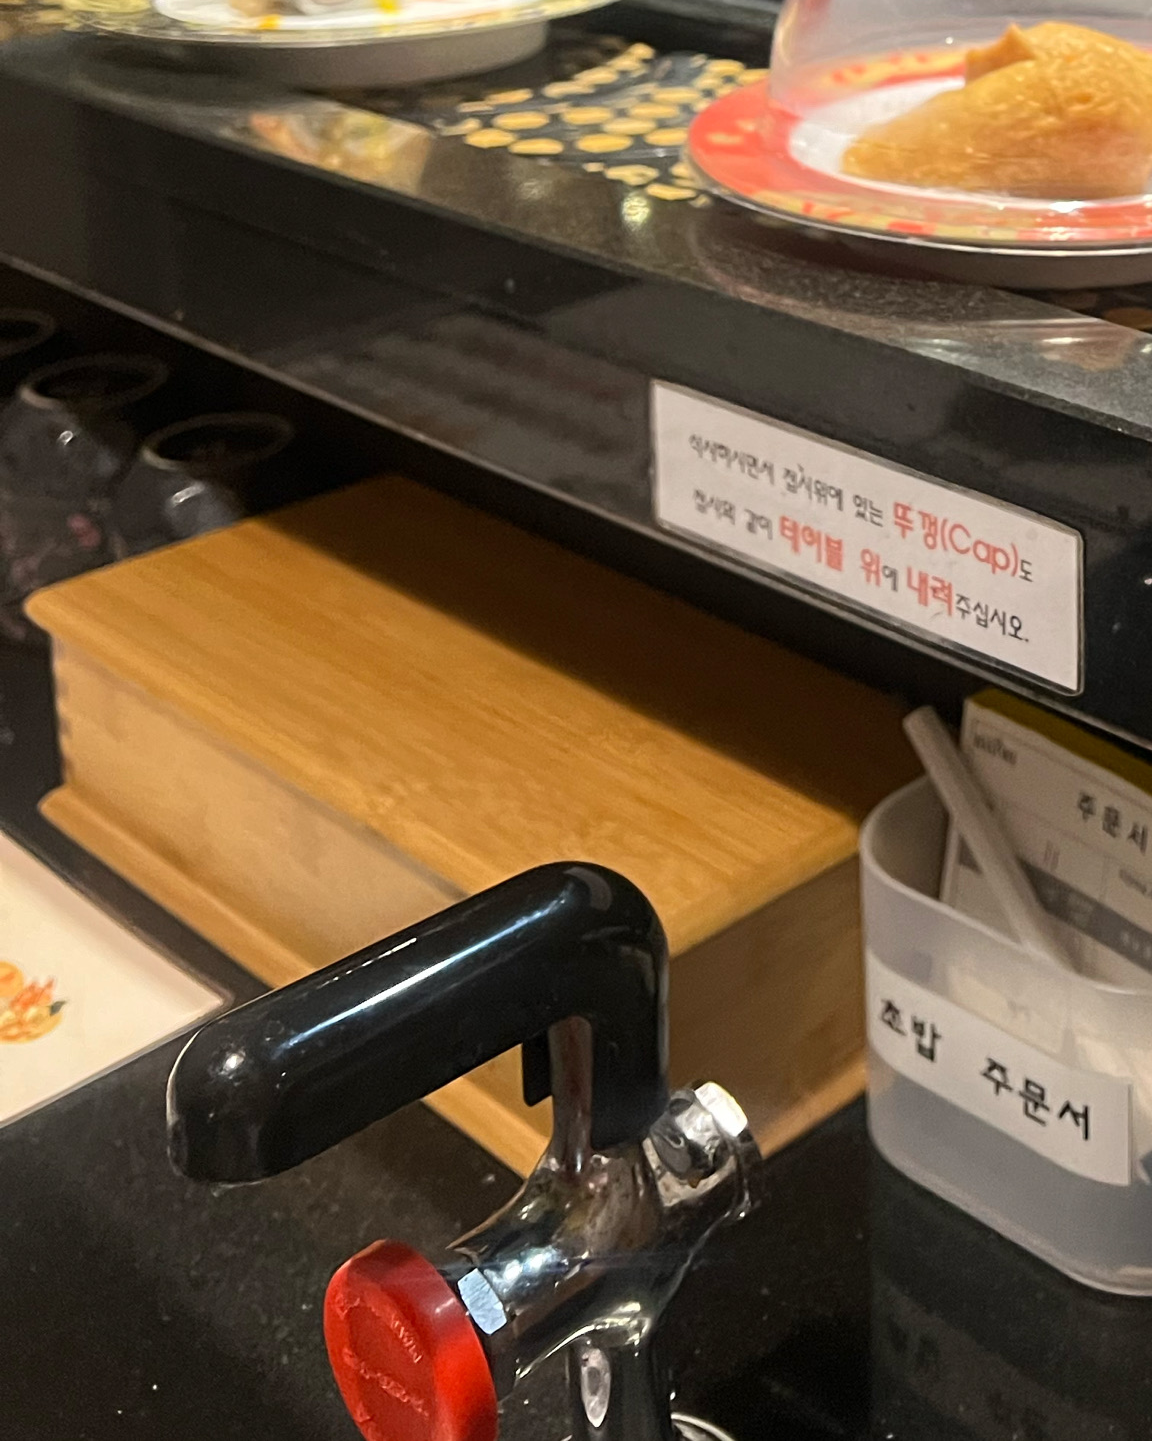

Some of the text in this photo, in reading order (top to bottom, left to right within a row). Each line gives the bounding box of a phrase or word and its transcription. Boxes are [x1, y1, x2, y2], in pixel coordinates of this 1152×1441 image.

[688, 433, 776, 486] 식사하시면서
[783, 463, 844, 512] 접시위에
[853, 494, 884, 528] 있는
[744, 508, 774, 541] 같이
[779, 514, 844, 572] 테이블
[860, 548, 898, 593] 위에
[1076, 790, 1149, 856] 주문서
[880, 998, 1090, 1142] 초밥 주문서
